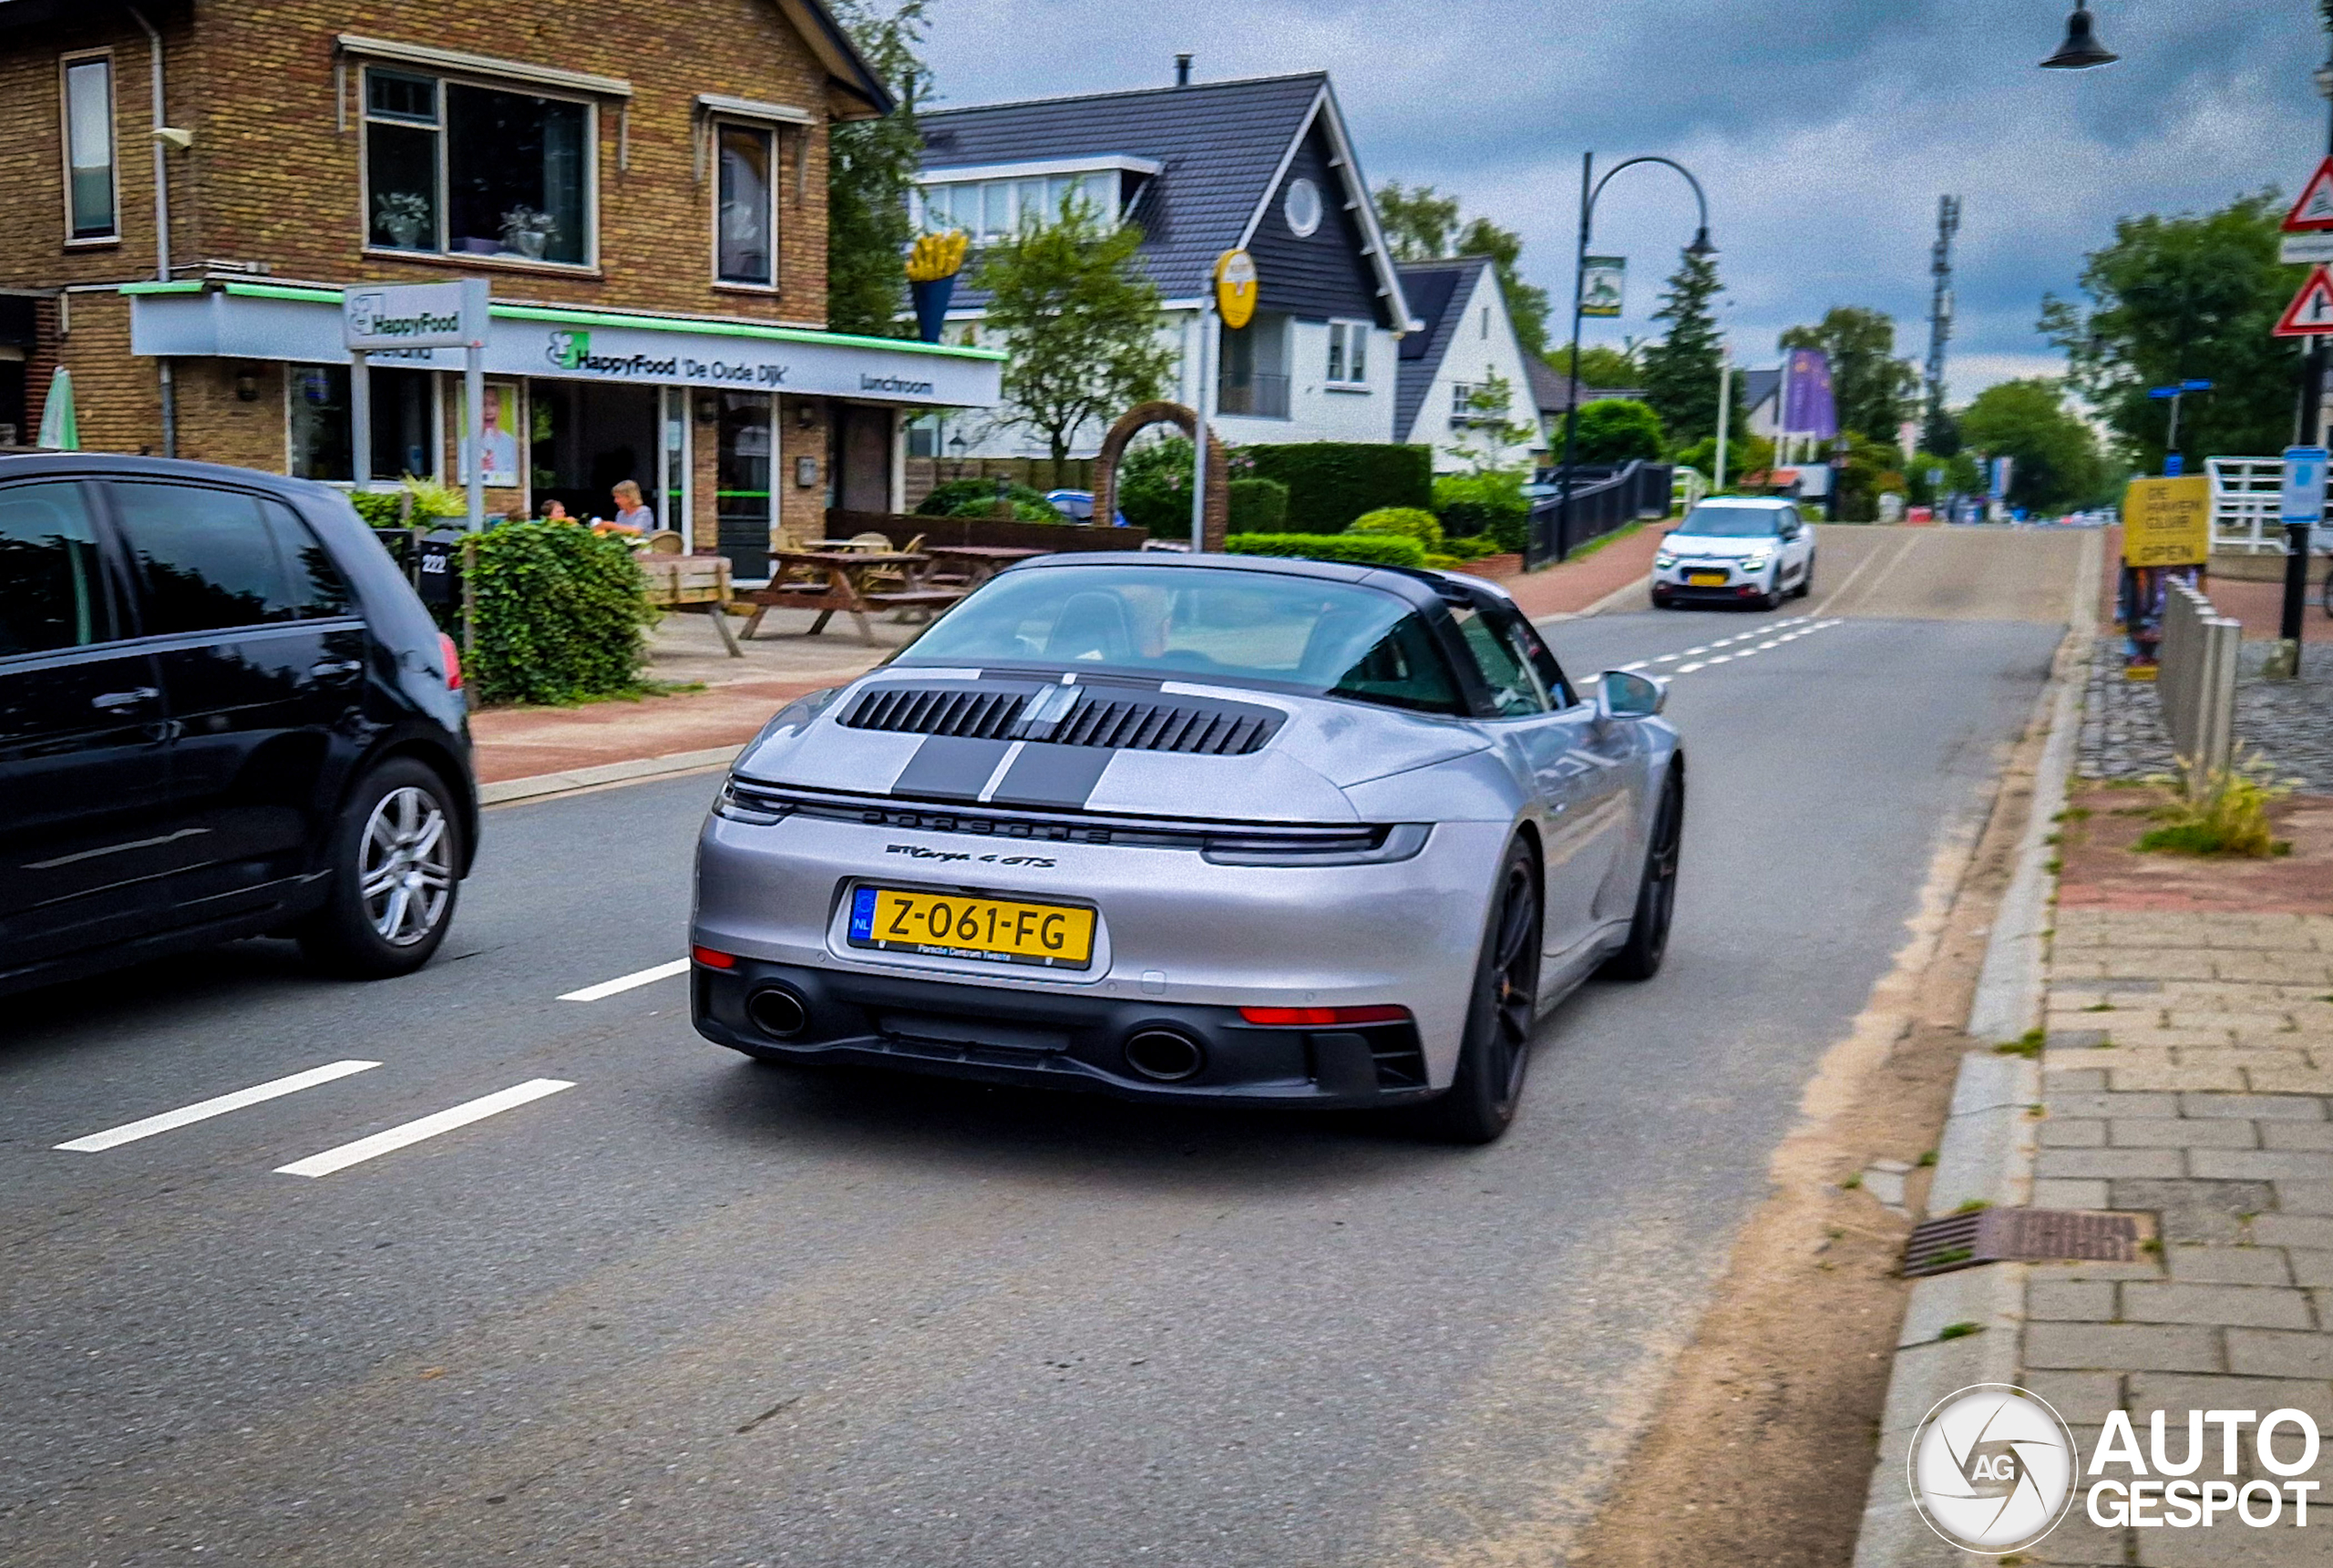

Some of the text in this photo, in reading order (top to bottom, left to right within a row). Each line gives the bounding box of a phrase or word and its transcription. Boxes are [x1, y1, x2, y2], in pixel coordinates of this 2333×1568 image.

[373, 311, 459, 337] HappyFood
[577, 350, 677, 375] HappyFood
[712, 361, 754, 382] Oude
[860, 373, 933, 395] Lunchroom
[422, 554, 447, 574] 222
[863, 811, 1111, 845] PORSCHE
[854, 918, 870, 930] NL
[889, 898, 1065, 950] Z-061-FG
[918, 944, 948, 956] Porsche
